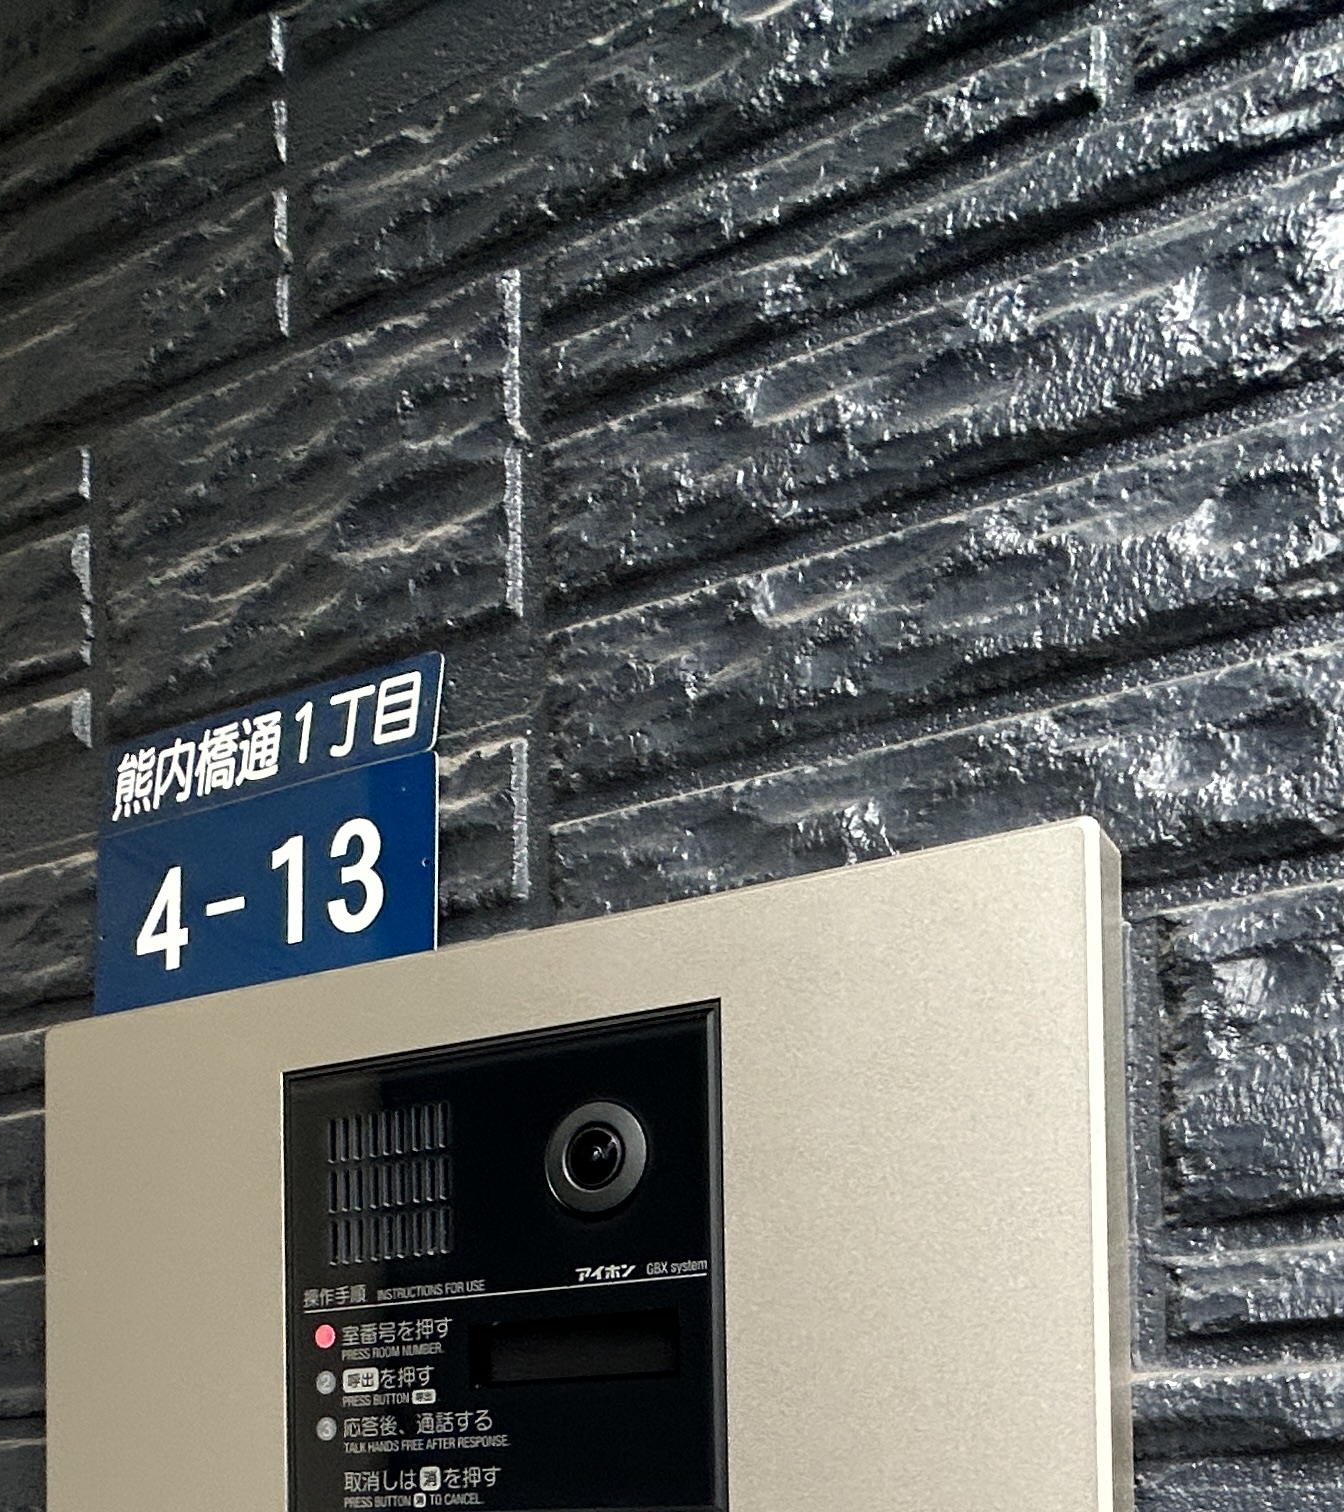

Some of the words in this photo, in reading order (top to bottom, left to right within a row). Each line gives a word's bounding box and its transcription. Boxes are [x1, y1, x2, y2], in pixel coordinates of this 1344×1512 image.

[136, 818, 385, 971] 4-13
[575, 1264, 636, 1281] アイホン
[670, 1260, 707, 1274] system
[303, 1284, 367, 1307] 操作手順
[376, 1284, 443, 1301] INSTRUCTIONS
[444, 1281, 465, 1294] FOR
[466, 1279, 486, 1292] USE
[341, 1317, 453, 1346] 室番号を押す
[341, 1345, 371, 1361] PRESS
[372, 1344, 400, 1359] ROOM
[342, 1393, 372, 1407] PRESS
[373, 1391, 409, 1406] BUTTON
[344, 1441, 368, 1454] TALK
[368, 1439, 400, 1453] HANDS
[401, 1437, 424, 1451] FREE
[425, 1435, 456, 1450] AFTER
[343, 1497, 373, 1509] PRESS
[374, 1495, 411, 1508] BUTTON
[430, 1494, 443, 1506] TO
